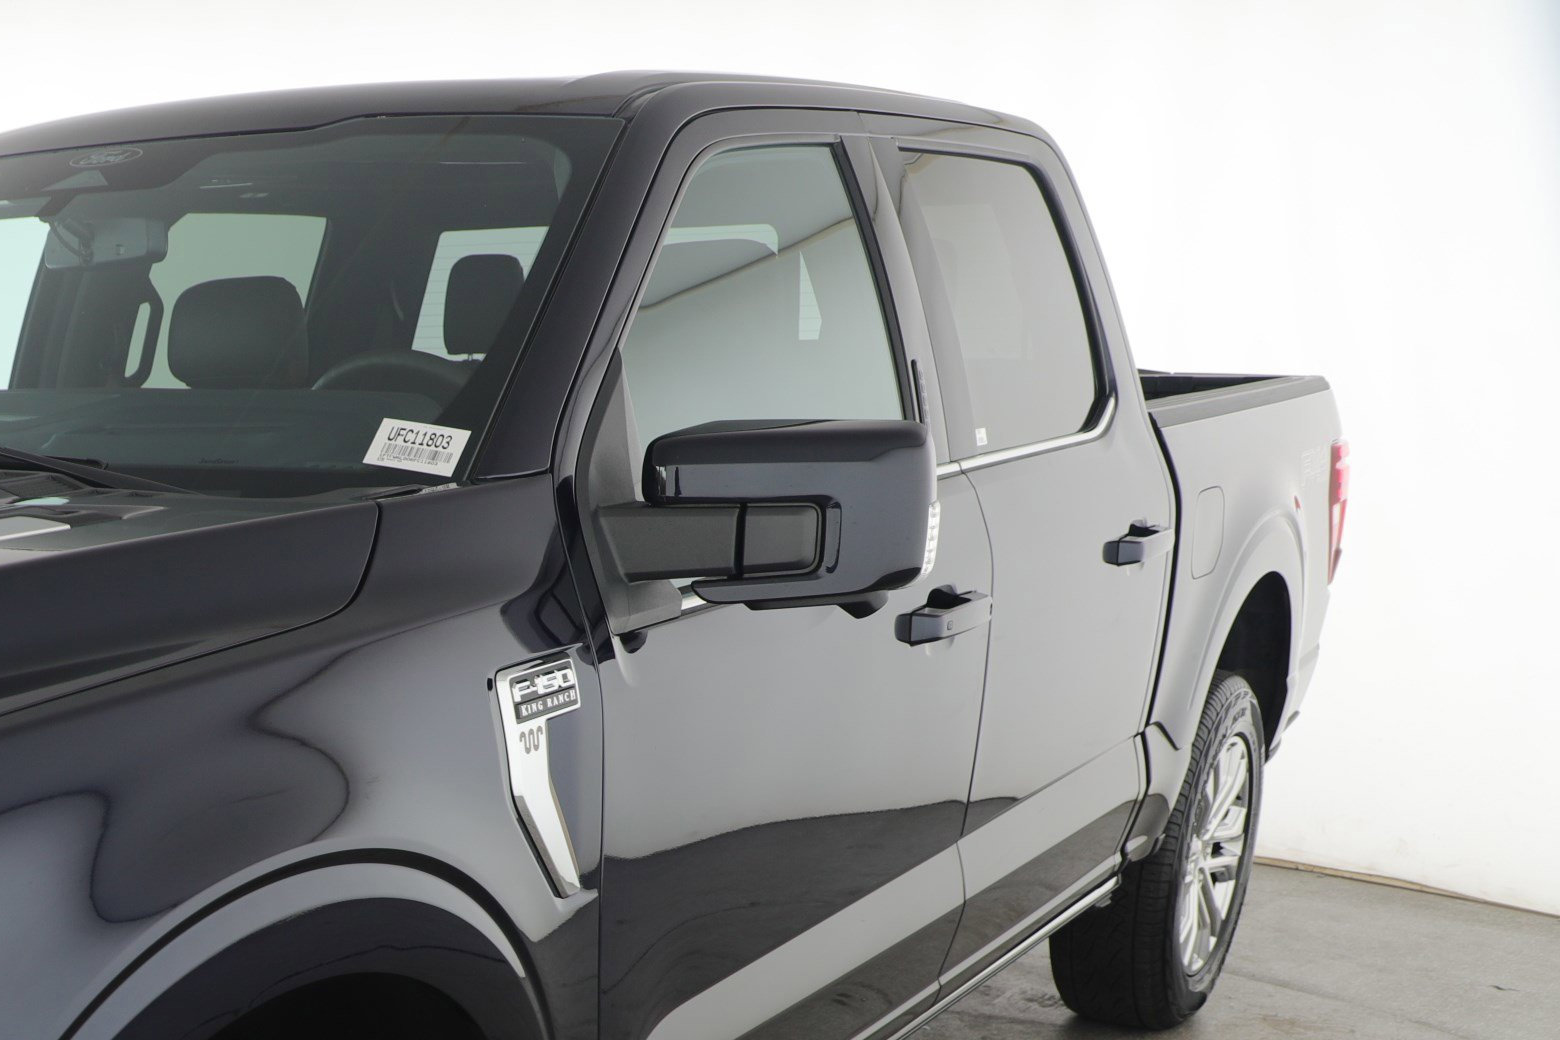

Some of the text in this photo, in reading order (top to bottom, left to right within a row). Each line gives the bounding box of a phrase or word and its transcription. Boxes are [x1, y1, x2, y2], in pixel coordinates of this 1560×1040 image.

[79, 150, 133, 165] Ford
[387, 427, 453, 450] UFC11803
[512, 668, 575, 702] F-150
[520, 690, 576, 717] KING RANCH
